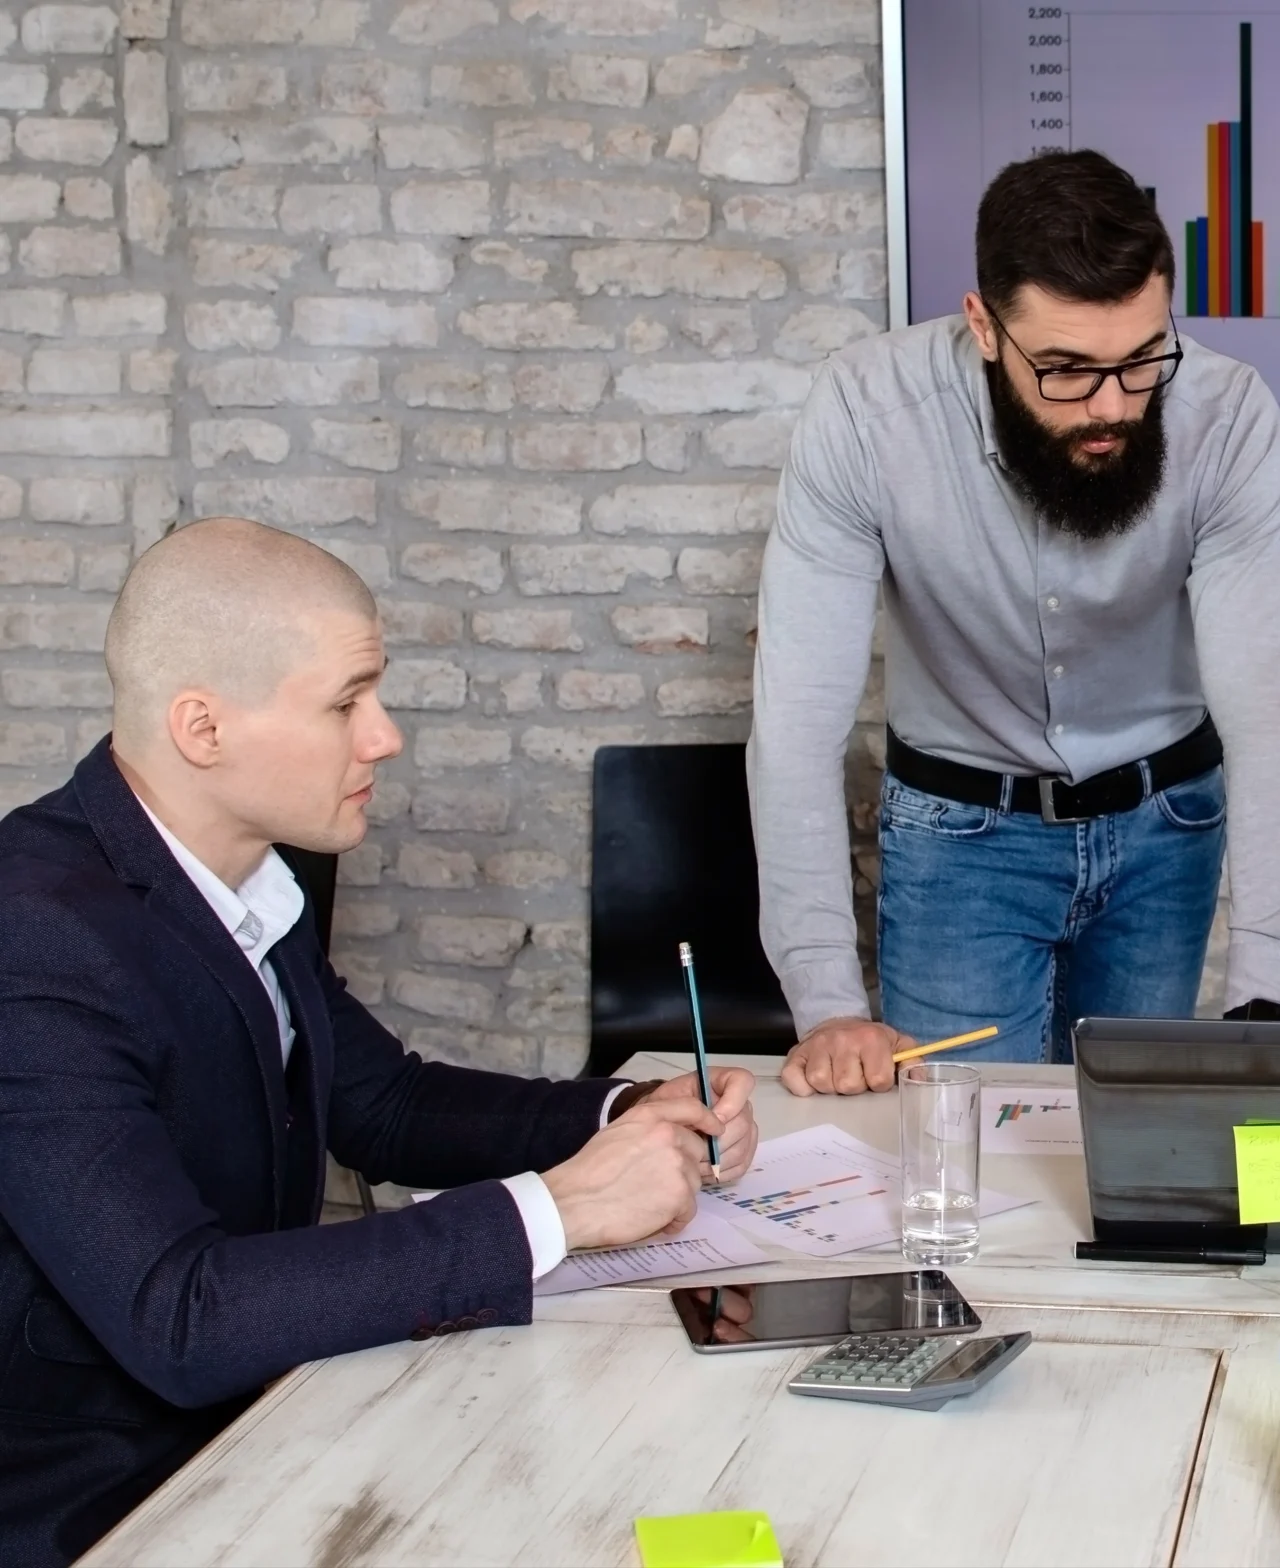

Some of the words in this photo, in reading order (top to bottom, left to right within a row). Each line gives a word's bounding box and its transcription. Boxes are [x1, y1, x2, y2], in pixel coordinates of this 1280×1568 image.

[1028, 8, 1062, 20] 2,200
[1028, 35, 1062, 48] 2,000
[1029, 64, 1063, 77] 1,800
[1030, 91, 1063, 104] 1,600
[1031, 118, 1063, 131] 1,400
